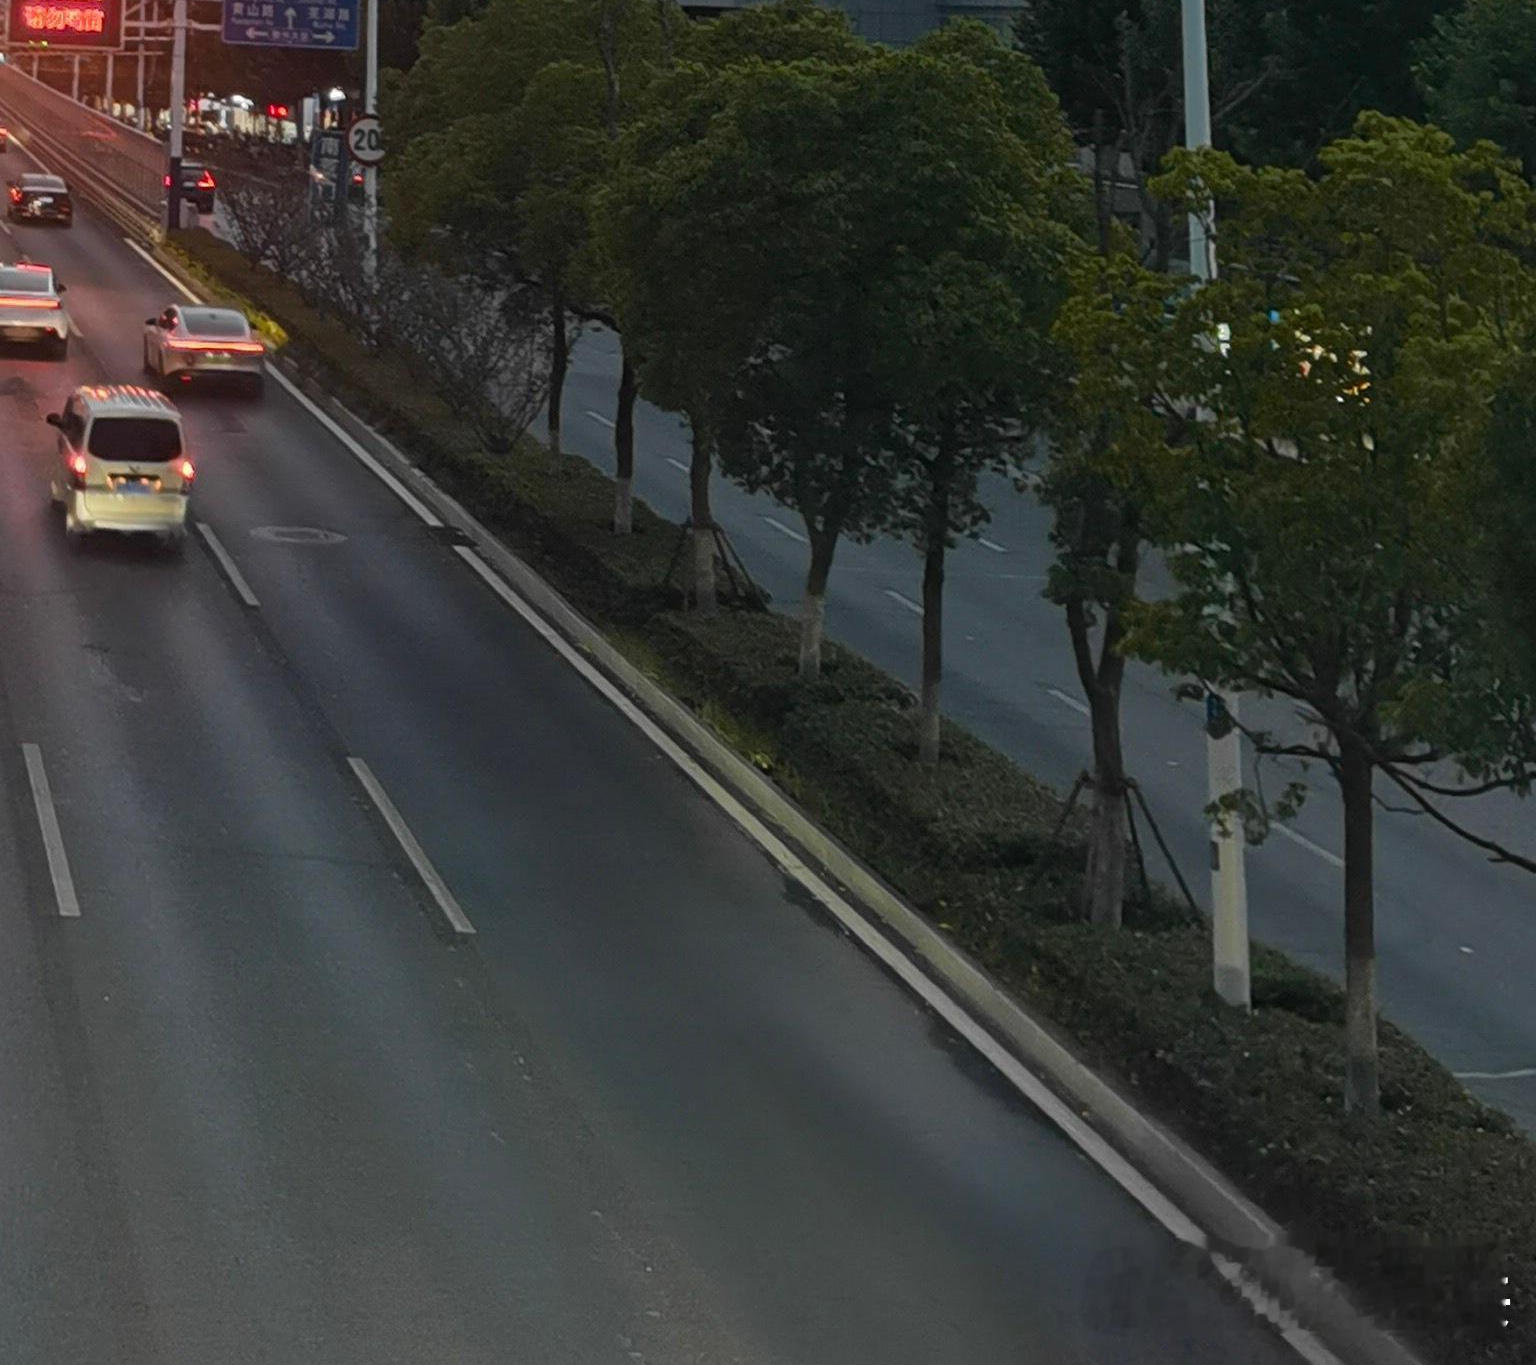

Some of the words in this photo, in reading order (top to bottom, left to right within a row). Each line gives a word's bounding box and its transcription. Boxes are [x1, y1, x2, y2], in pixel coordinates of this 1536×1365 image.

[24, 5, 104, 32] 请勿鸣笛
[354, 129, 379, 151] 20
